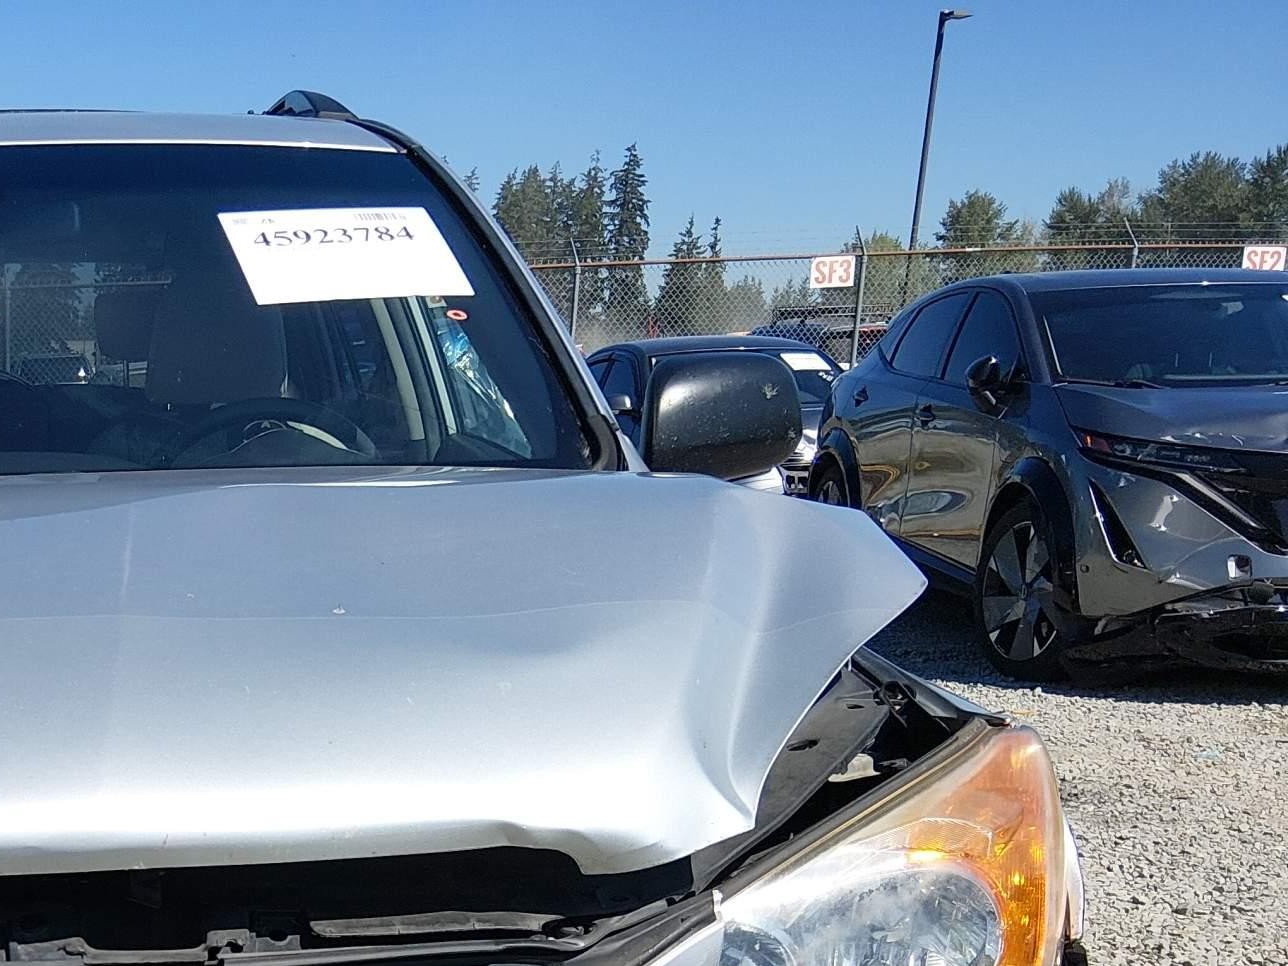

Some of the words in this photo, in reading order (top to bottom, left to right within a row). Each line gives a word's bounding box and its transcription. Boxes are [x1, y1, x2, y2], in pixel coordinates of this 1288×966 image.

[254, 226, 414, 246] 45923784
[1247, 250, 1282, 271] SF2
[814, 260, 852, 284] SF3
